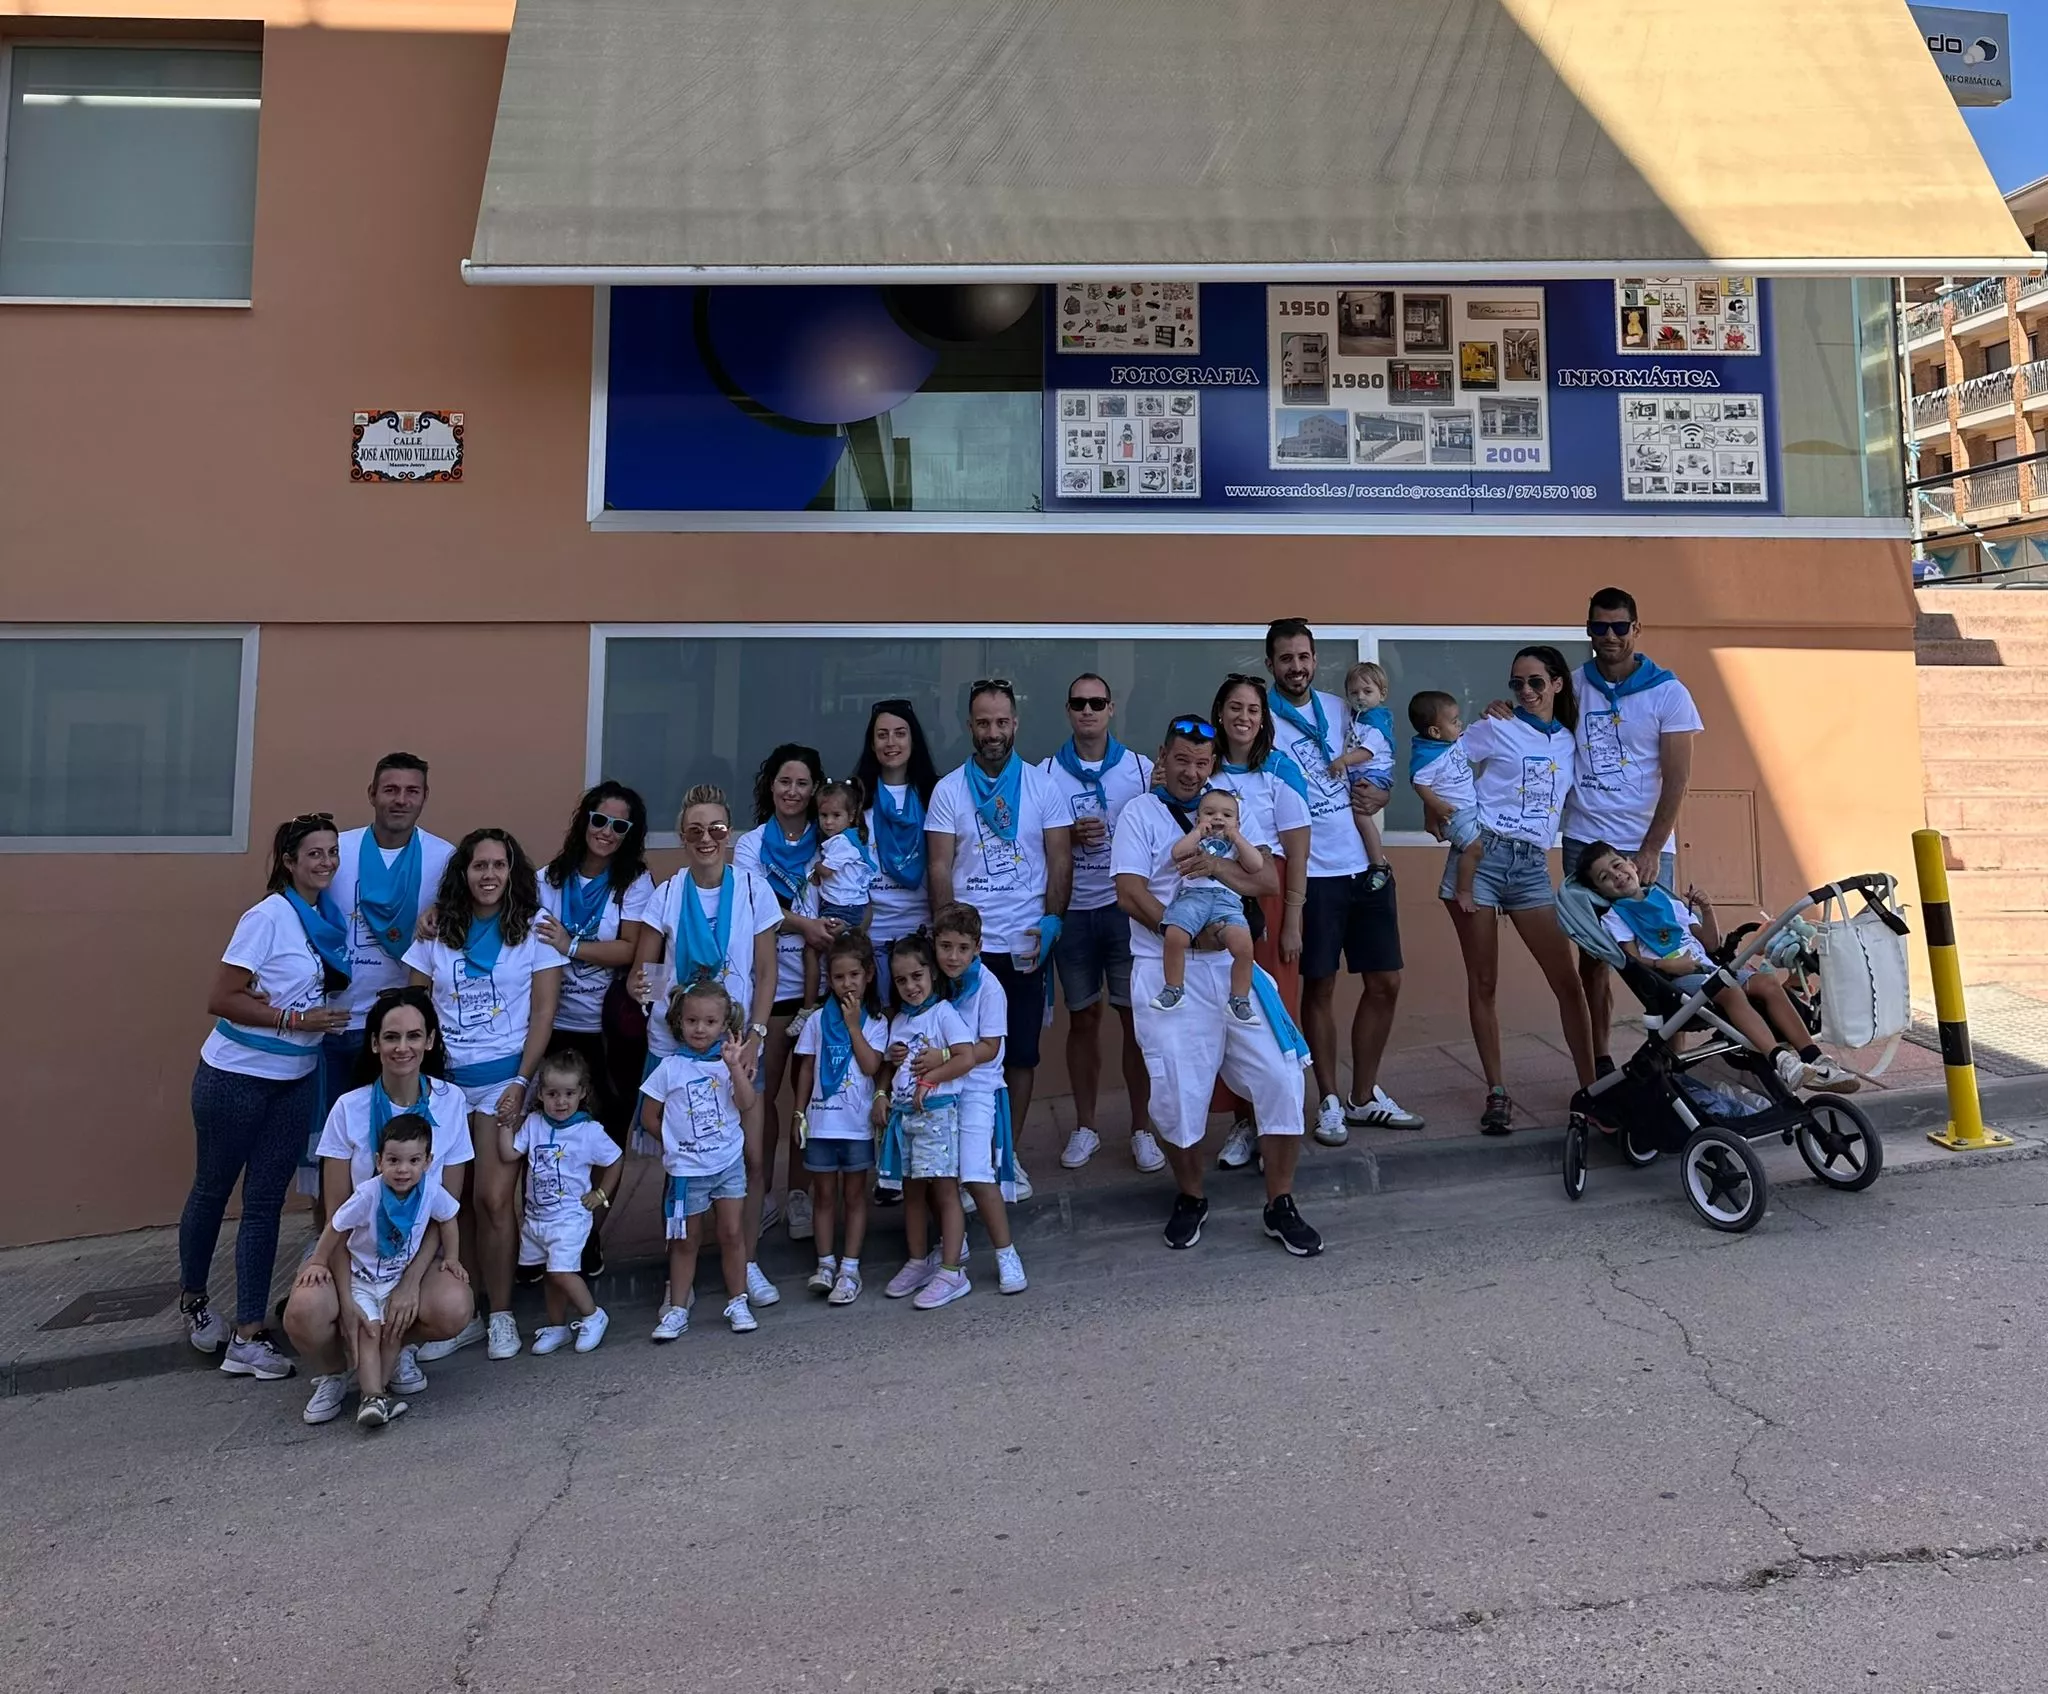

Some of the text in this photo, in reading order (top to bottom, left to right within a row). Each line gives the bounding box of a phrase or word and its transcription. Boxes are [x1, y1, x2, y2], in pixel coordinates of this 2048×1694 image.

[1279, 301, 1330, 316] 1950
[1111, 367, 1260, 385] FOTOGRAFIA
[1332, 373, 1384, 389] 1980
[1558, 366, 1721, 387] INFORMÁTICA
[393, 437, 422, 445] CALLE
[360, 446, 455, 461] JOSÉ ANTONIO VILLELLAS
[1486, 447, 1540, 463] 2004
[1225, 483, 1596, 499] www.rosendosl.es / rosendo@rosendosl.es / 974 570 103
